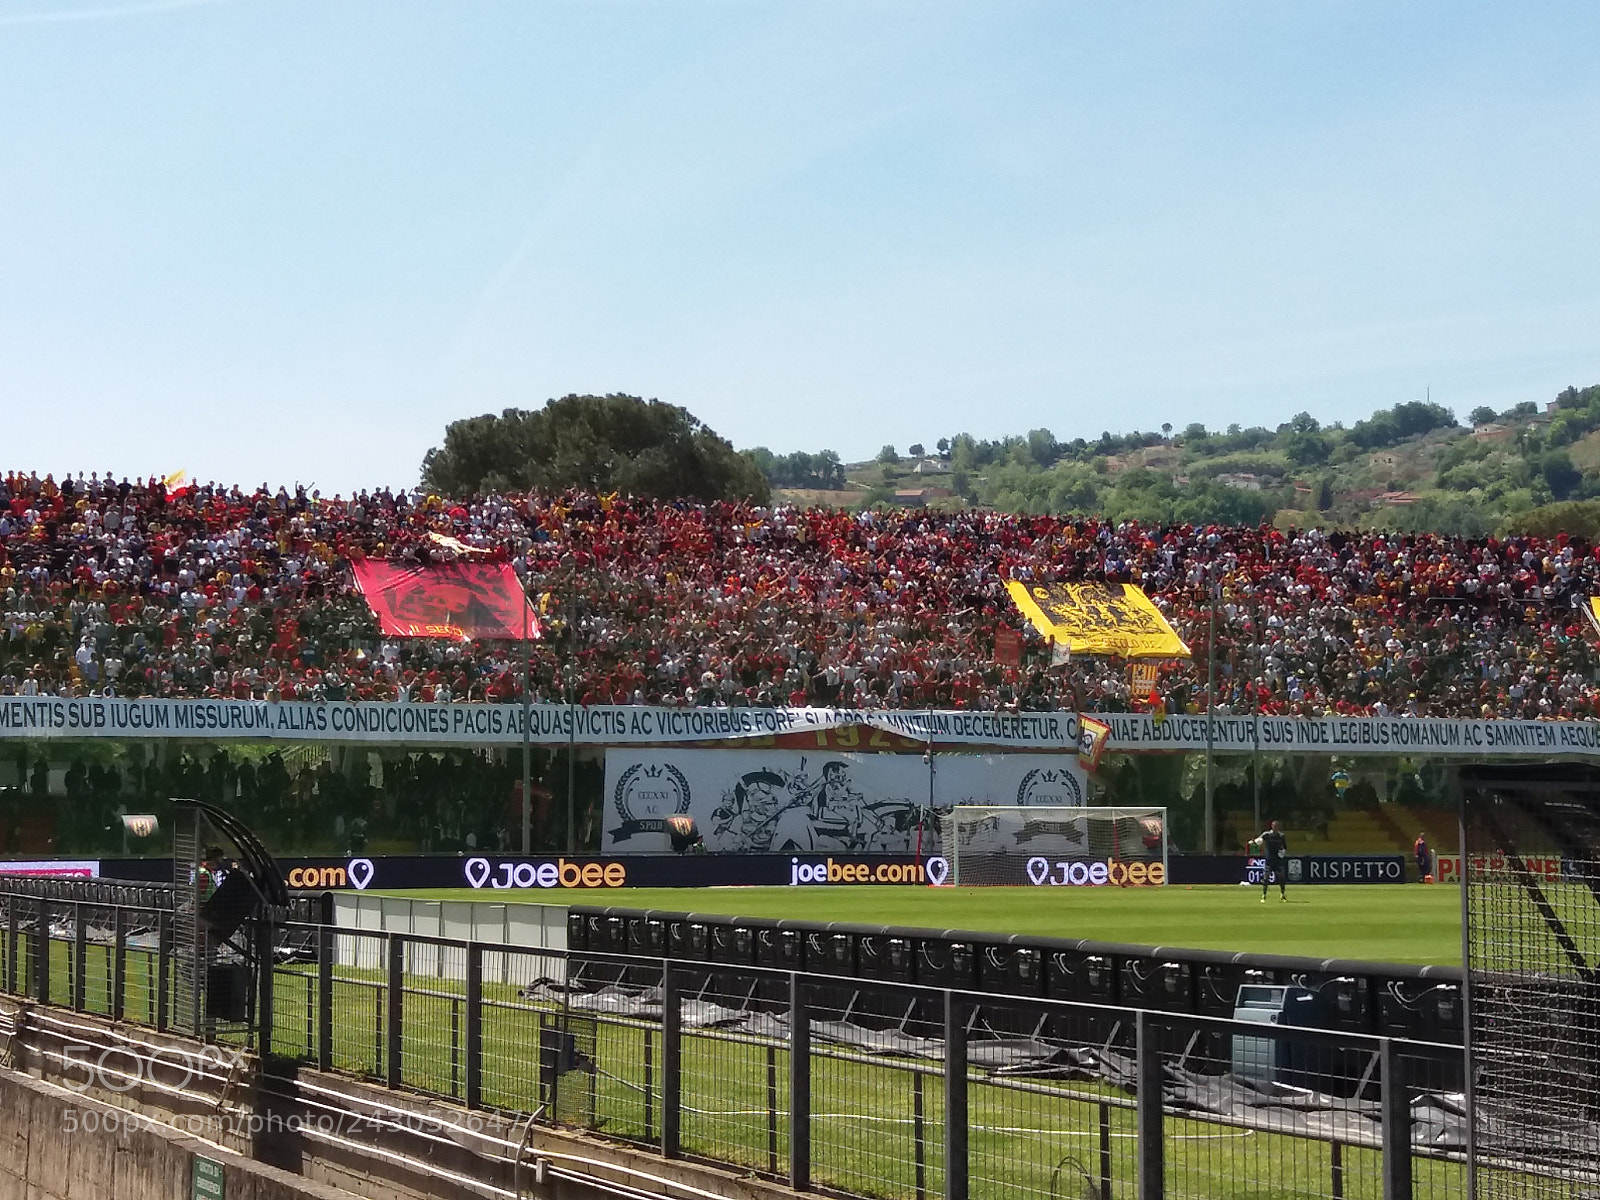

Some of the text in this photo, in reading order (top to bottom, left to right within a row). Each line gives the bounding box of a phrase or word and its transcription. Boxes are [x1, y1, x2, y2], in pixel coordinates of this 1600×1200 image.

[69, 703, 106, 728] SUB
[110, 703, 170, 729] IUGUM
[174, 704, 274, 730] MISSURUM,
[277, 706, 327, 731] ALIAS
[331, 707, 449, 733] CONDICIONES
[453, 709, 502, 734] PACIS
[575, 710, 626, 735] VICTIS
[630, 711, 652, 735] AC
[655, 711, 752, 735] VICTORIBUS
[1263, 720, 1293, 743] SUIS
[1297, 721, 1329, 744] INDE
[1332, 721, 1389, 745] LEGIBUS
[1391, 723, 1460, 745] ROMANUM
[1464, 724, 1483, 745] AC
[1485, 725, 1556, 746] SAMNITEM
[789, 857, 925, 886] joebee.com
[1310, 861, 1400, 879] RISPETTO
